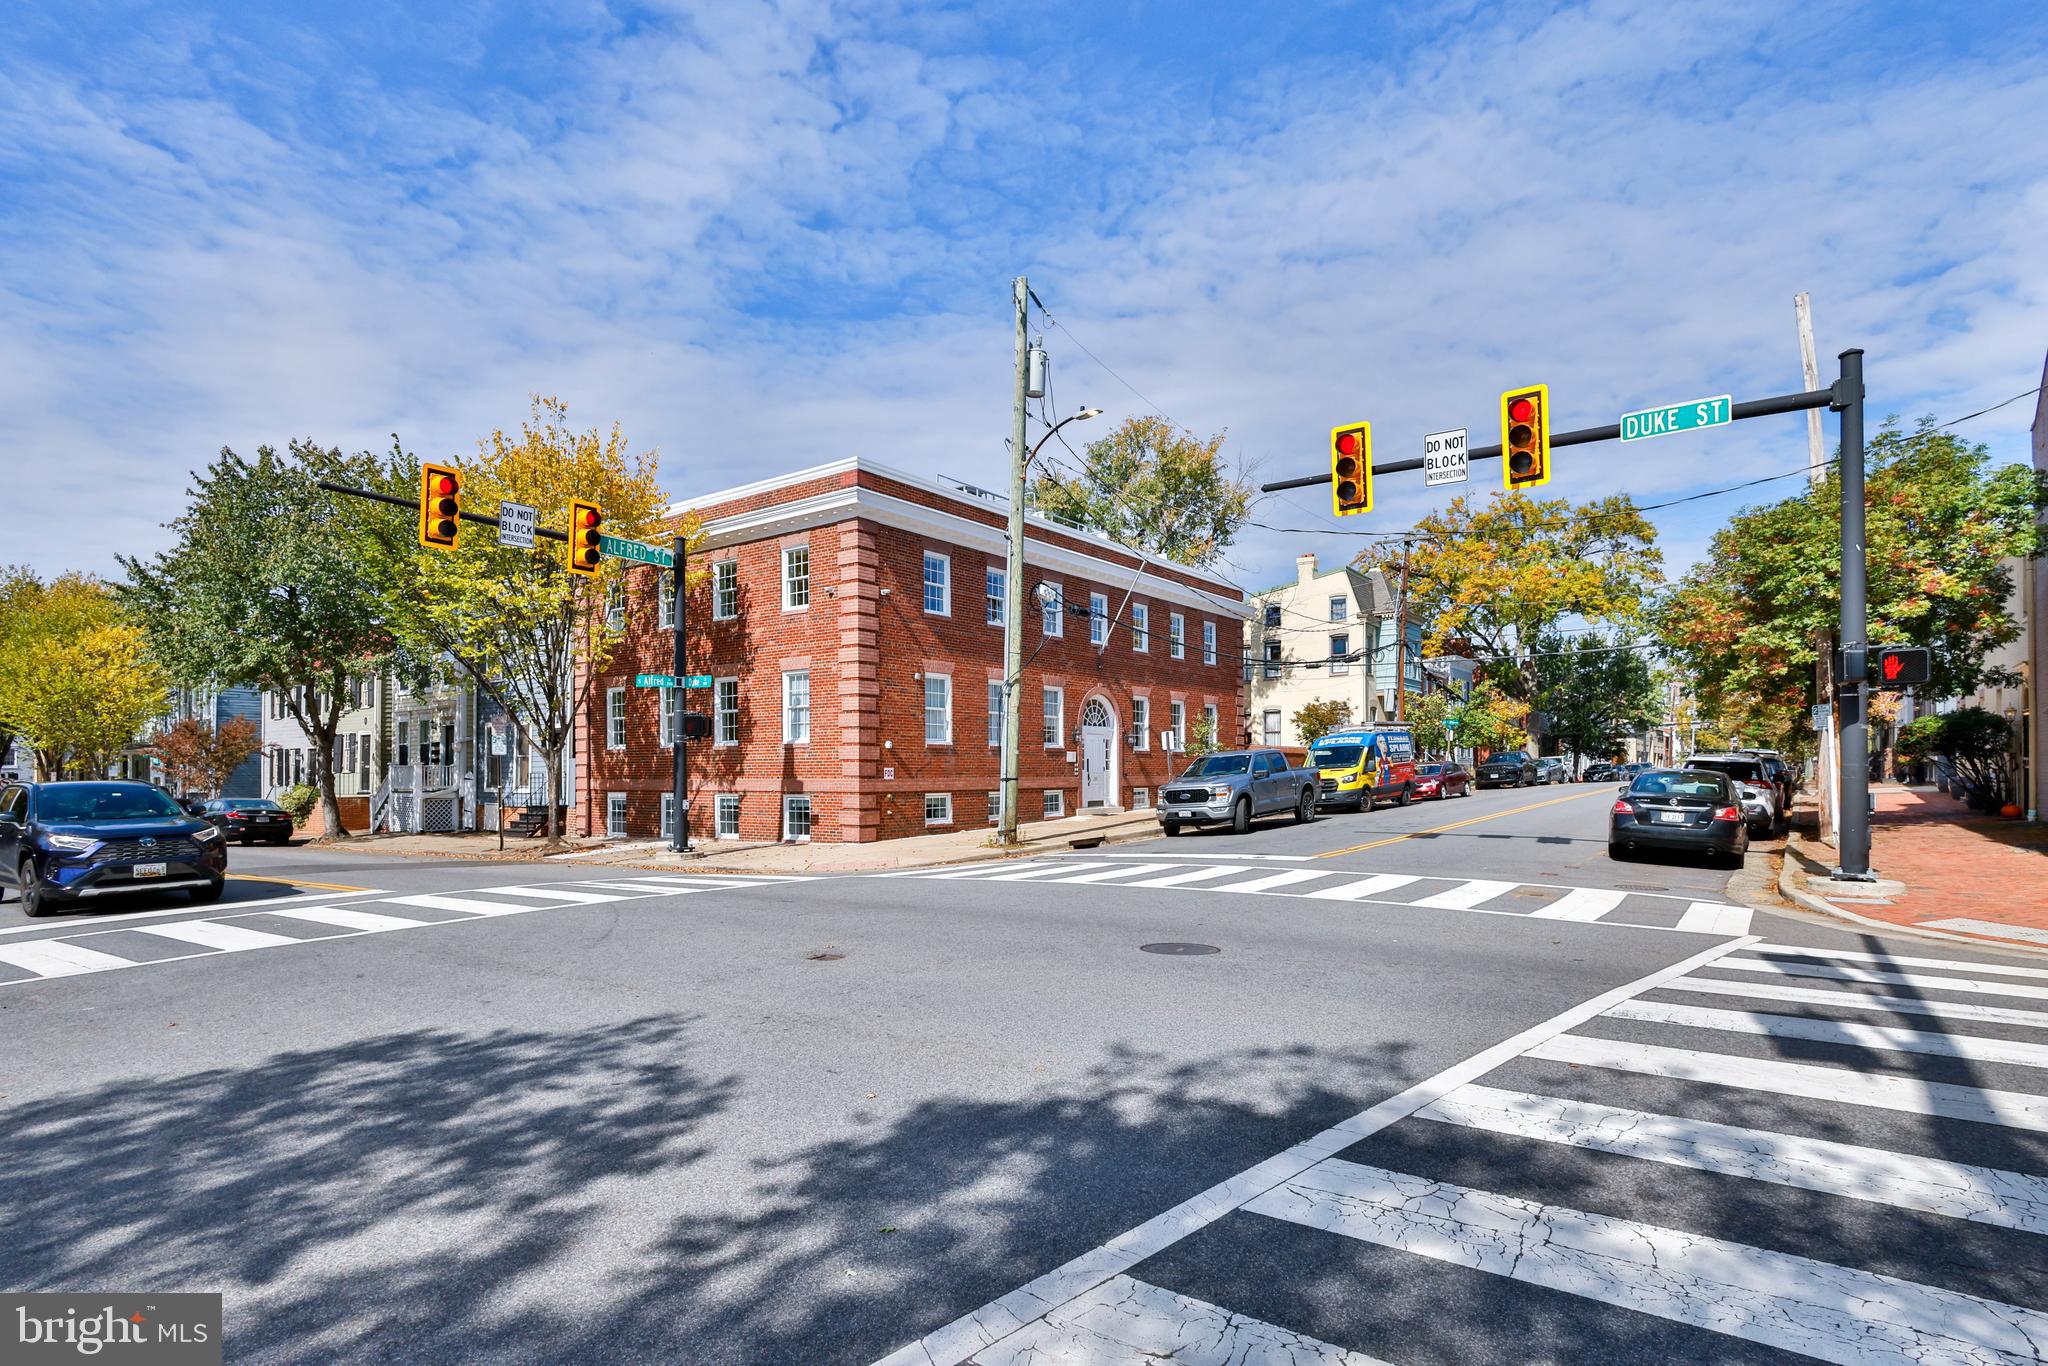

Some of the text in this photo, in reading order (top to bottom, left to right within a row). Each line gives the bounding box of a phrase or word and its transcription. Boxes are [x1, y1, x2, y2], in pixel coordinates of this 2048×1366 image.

[1626, 400, 1723, 438] DUKE ST
[1426, 435, 1465, 453] DO NOT
[1427, 453, 1466, 470] BLOCK
[1427, 468, 1466, 481] INTERSECTION
[502, 506, 533, 522] DO NOT
[501, 519, 533, 536] BLOCK
[501, 533, 533, 545] INTERSECTION
[606, 539, 667, 564] ALFRED ST
[643, 675, 664, 686] Alfred
